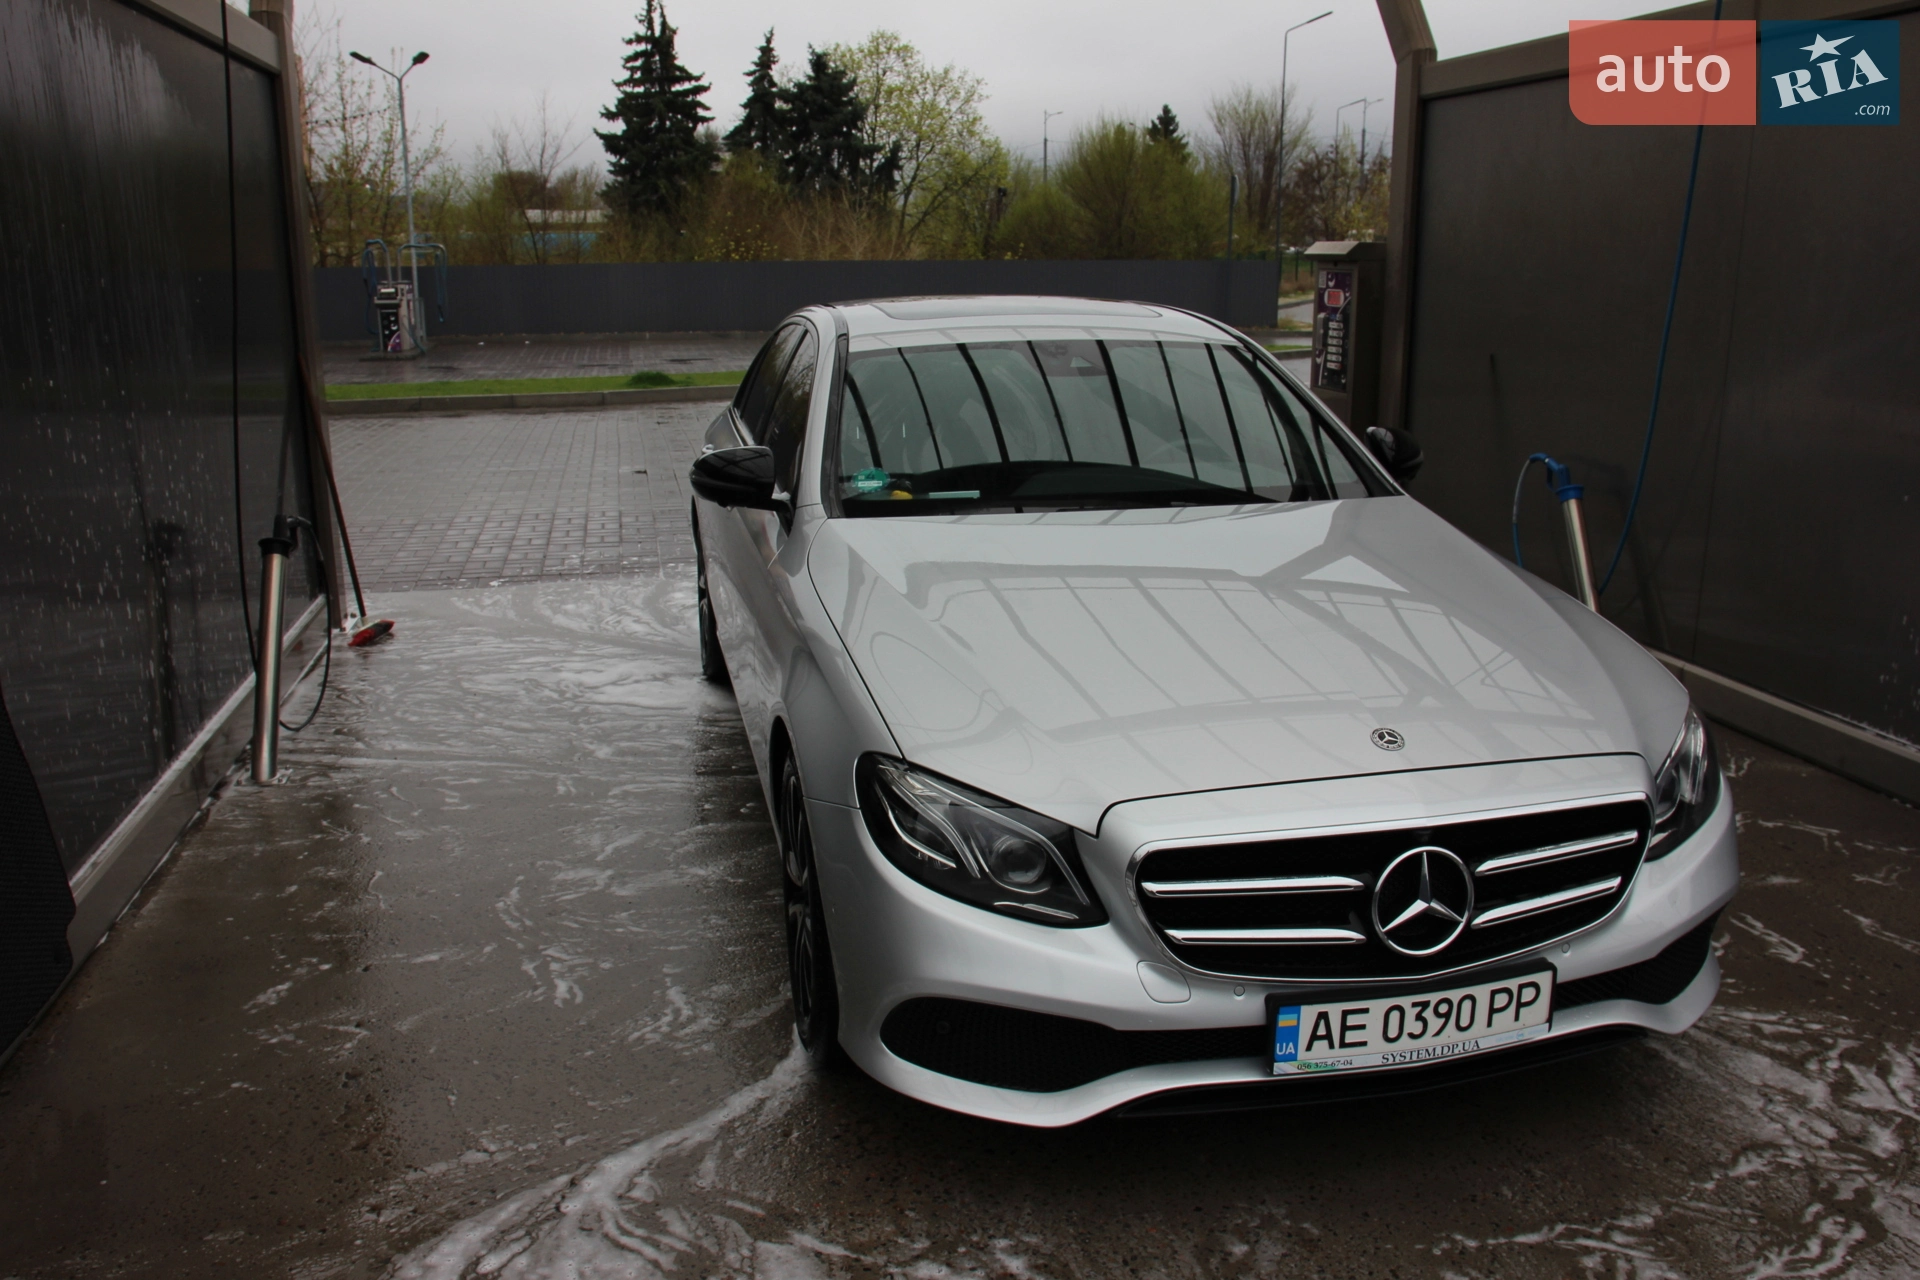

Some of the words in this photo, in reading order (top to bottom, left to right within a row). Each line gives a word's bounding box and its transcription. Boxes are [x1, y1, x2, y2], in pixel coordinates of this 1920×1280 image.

[1305, 1008, 1370, 1052] AE
[1382, 993, 1477, 1043] 0390
[1487, 980, 1541, 1028] PP
[1276, 1044, 1296, 1055] UA
[1381, 1039, 1480, 1064] SYSTEM.DP.UA
